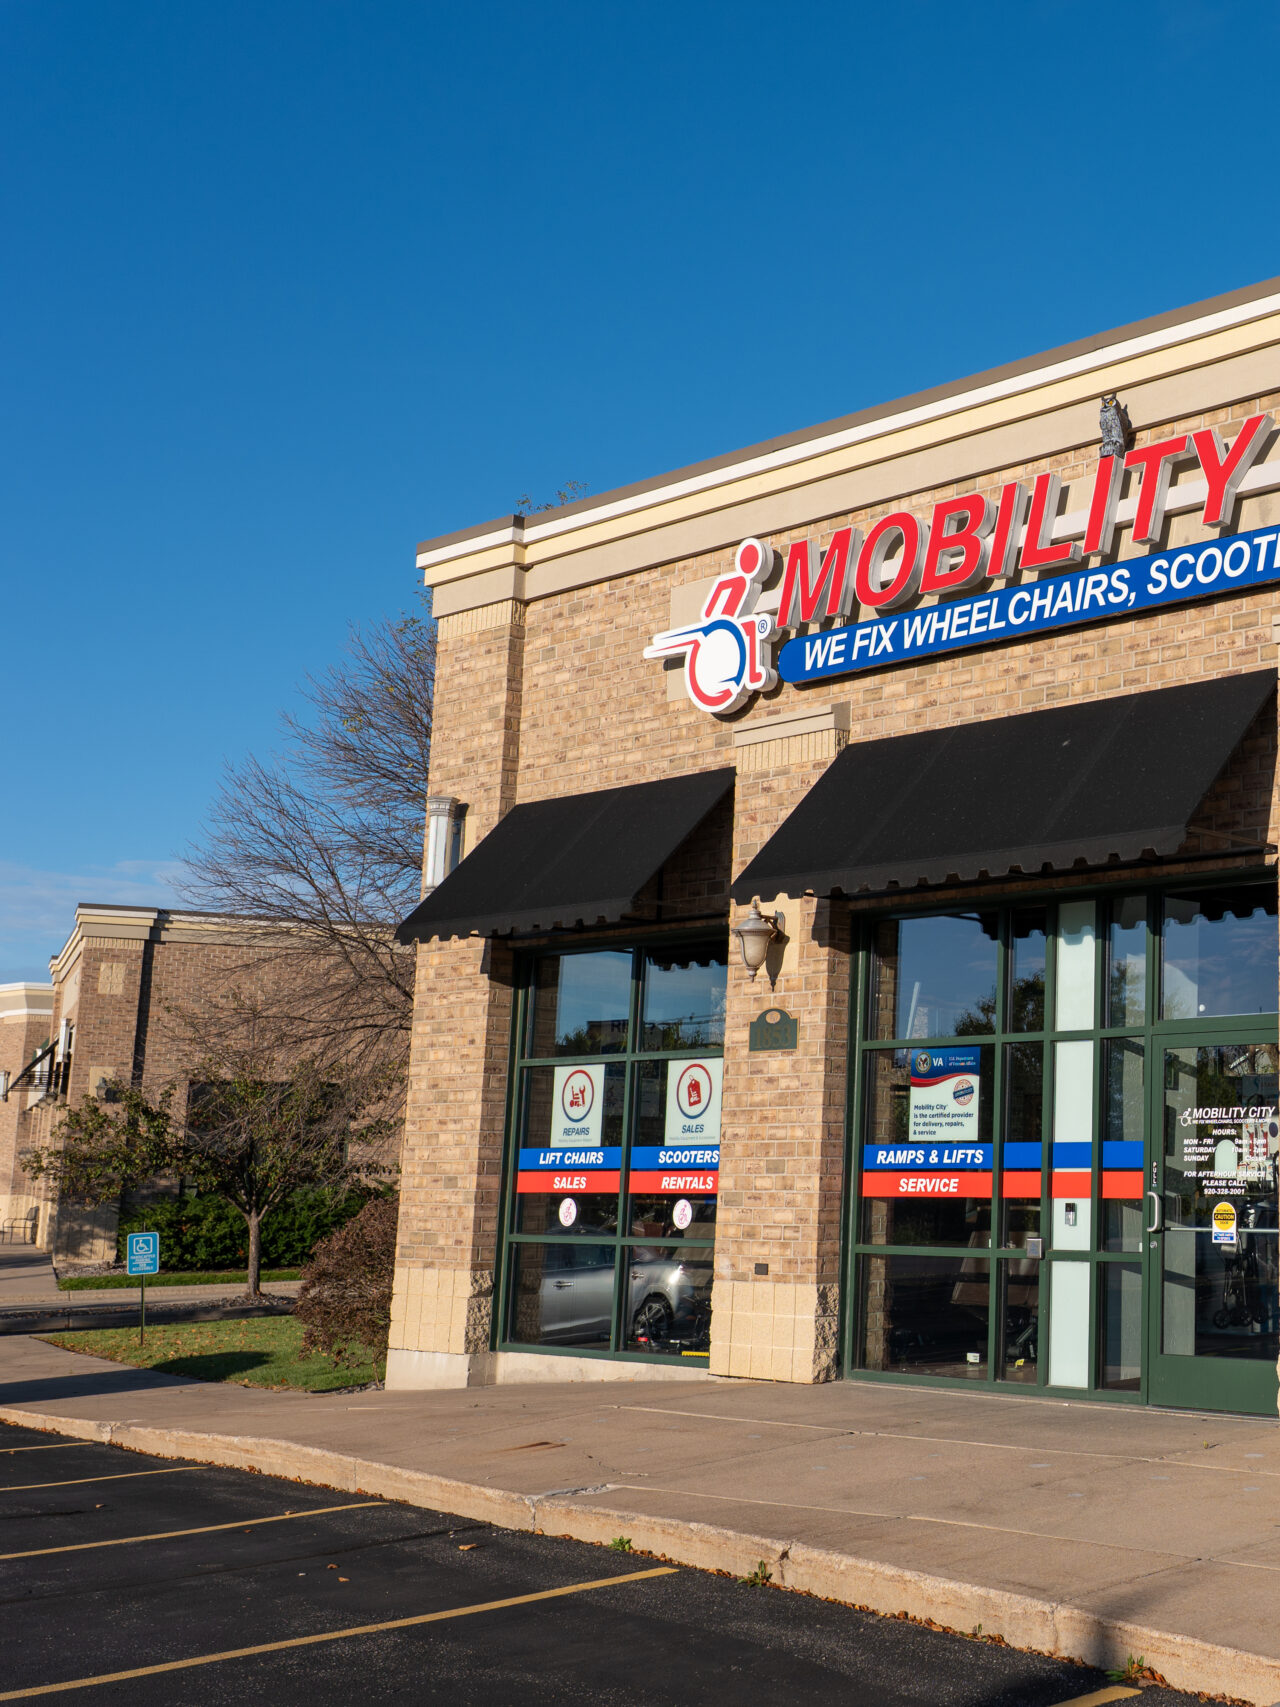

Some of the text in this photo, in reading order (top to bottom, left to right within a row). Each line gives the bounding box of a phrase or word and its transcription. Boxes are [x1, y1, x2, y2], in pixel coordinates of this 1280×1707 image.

[777, 414, 1270, 628] MOBILITY
[804, 633, 848, 671] WE
[852, 621, 898, 661] FIX
[754, 1024, 793, 1048] 1853
[932, 1057, 944, 1067] VA
[951, 1111, 974, 1119] provider
[1192, 1106, 1276, 1119] MOBILITY CITY
[681, 1124, 704, 1133] SALES
[922, 1120, 943, 1128] delivery,
[563, 1127, 590, 1137] REPAIRS
[1212, 1128, 1237, 1136] HOURS:
[539, 1151, 604, 1165] LIFT CHAIRS
[658, 1150, 720, 1163] SCOOTERS
[876, 1149, 984, 1164] RAMPS & LIFTS
[553, 1176, 587, 1189] SALES
[661, 1176, 714, 1189] RENTALS
[898, 1178, 959, 1192] SERVICE
